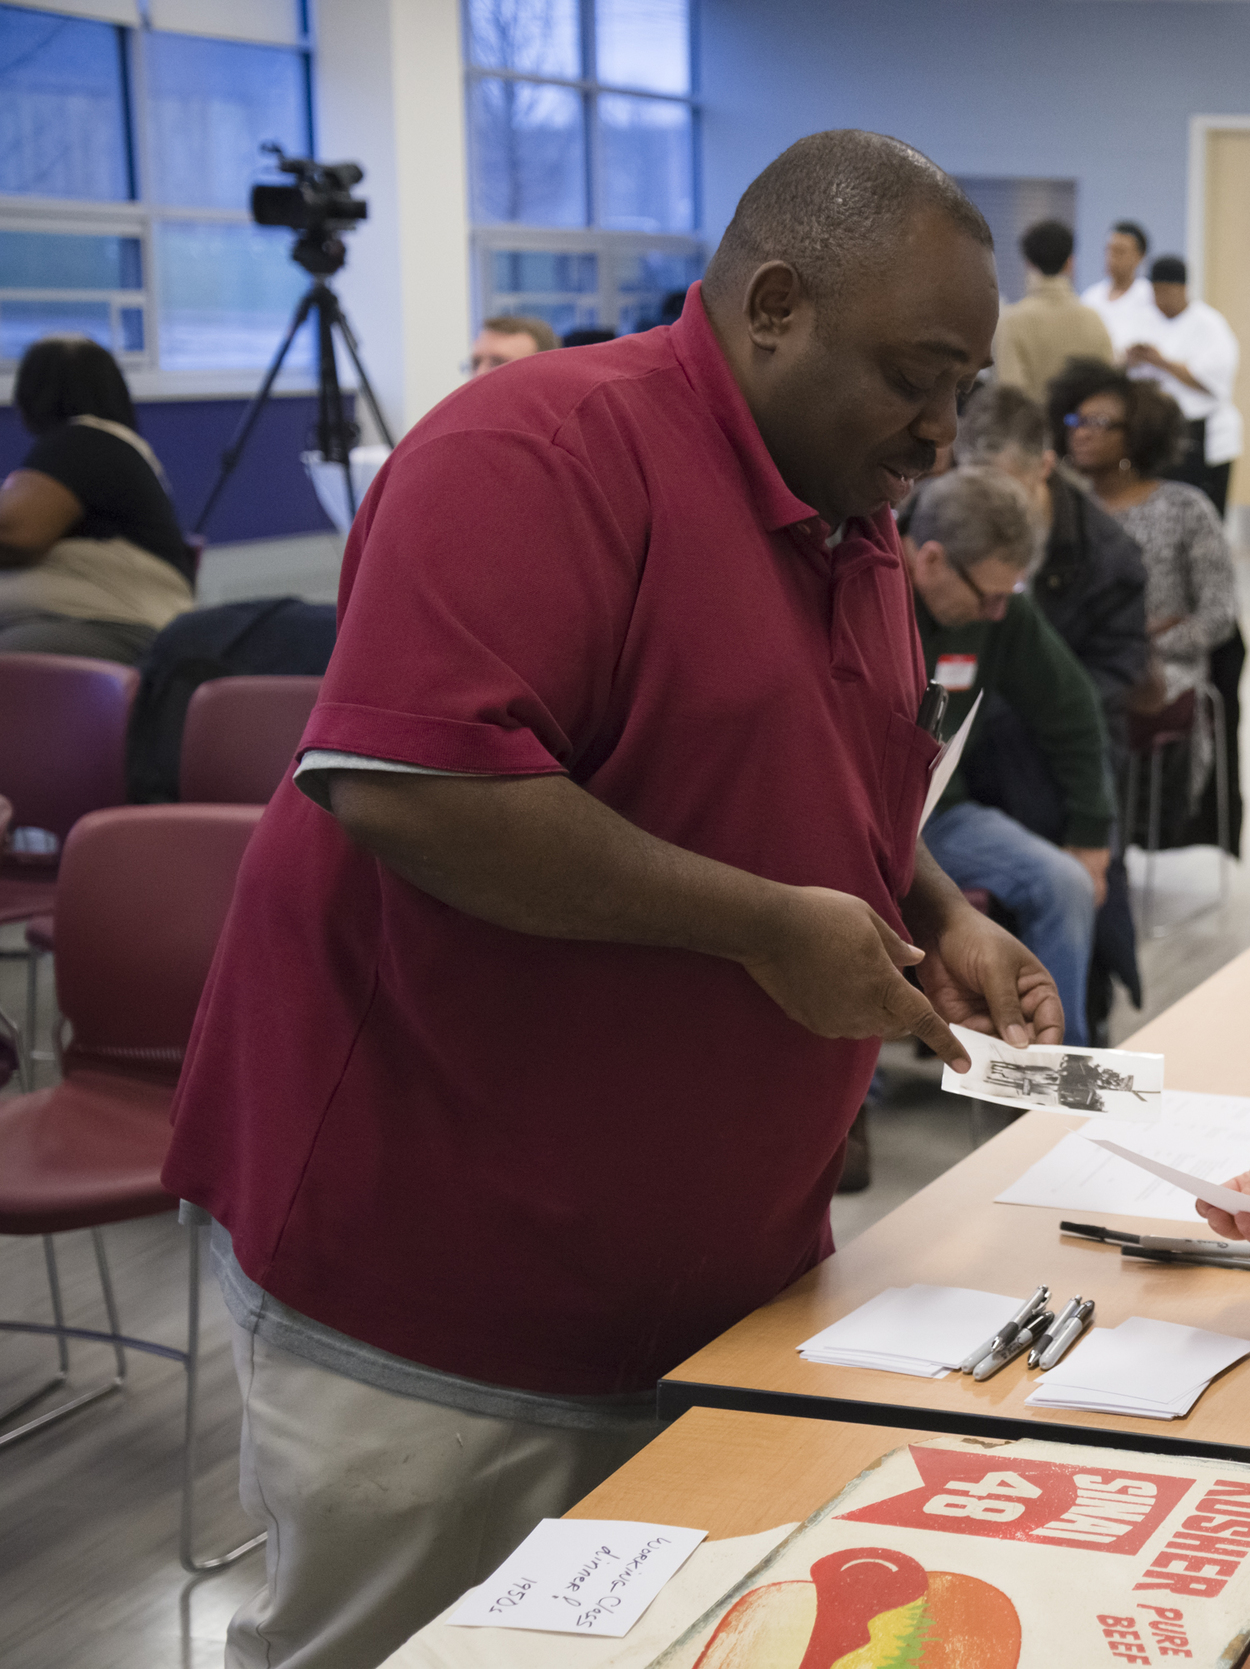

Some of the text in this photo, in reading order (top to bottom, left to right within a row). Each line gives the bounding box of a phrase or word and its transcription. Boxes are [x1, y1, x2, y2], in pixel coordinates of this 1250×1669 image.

[922, 1470, 1043, 1522] 48
[1028, 1473, 1158, 1544] SINAI
[488, 1577, 538, 1613] 1950s
[1096, 1614, 1152, 1666] BEEF
[1136, 1602, 1193, 1658] PURE
